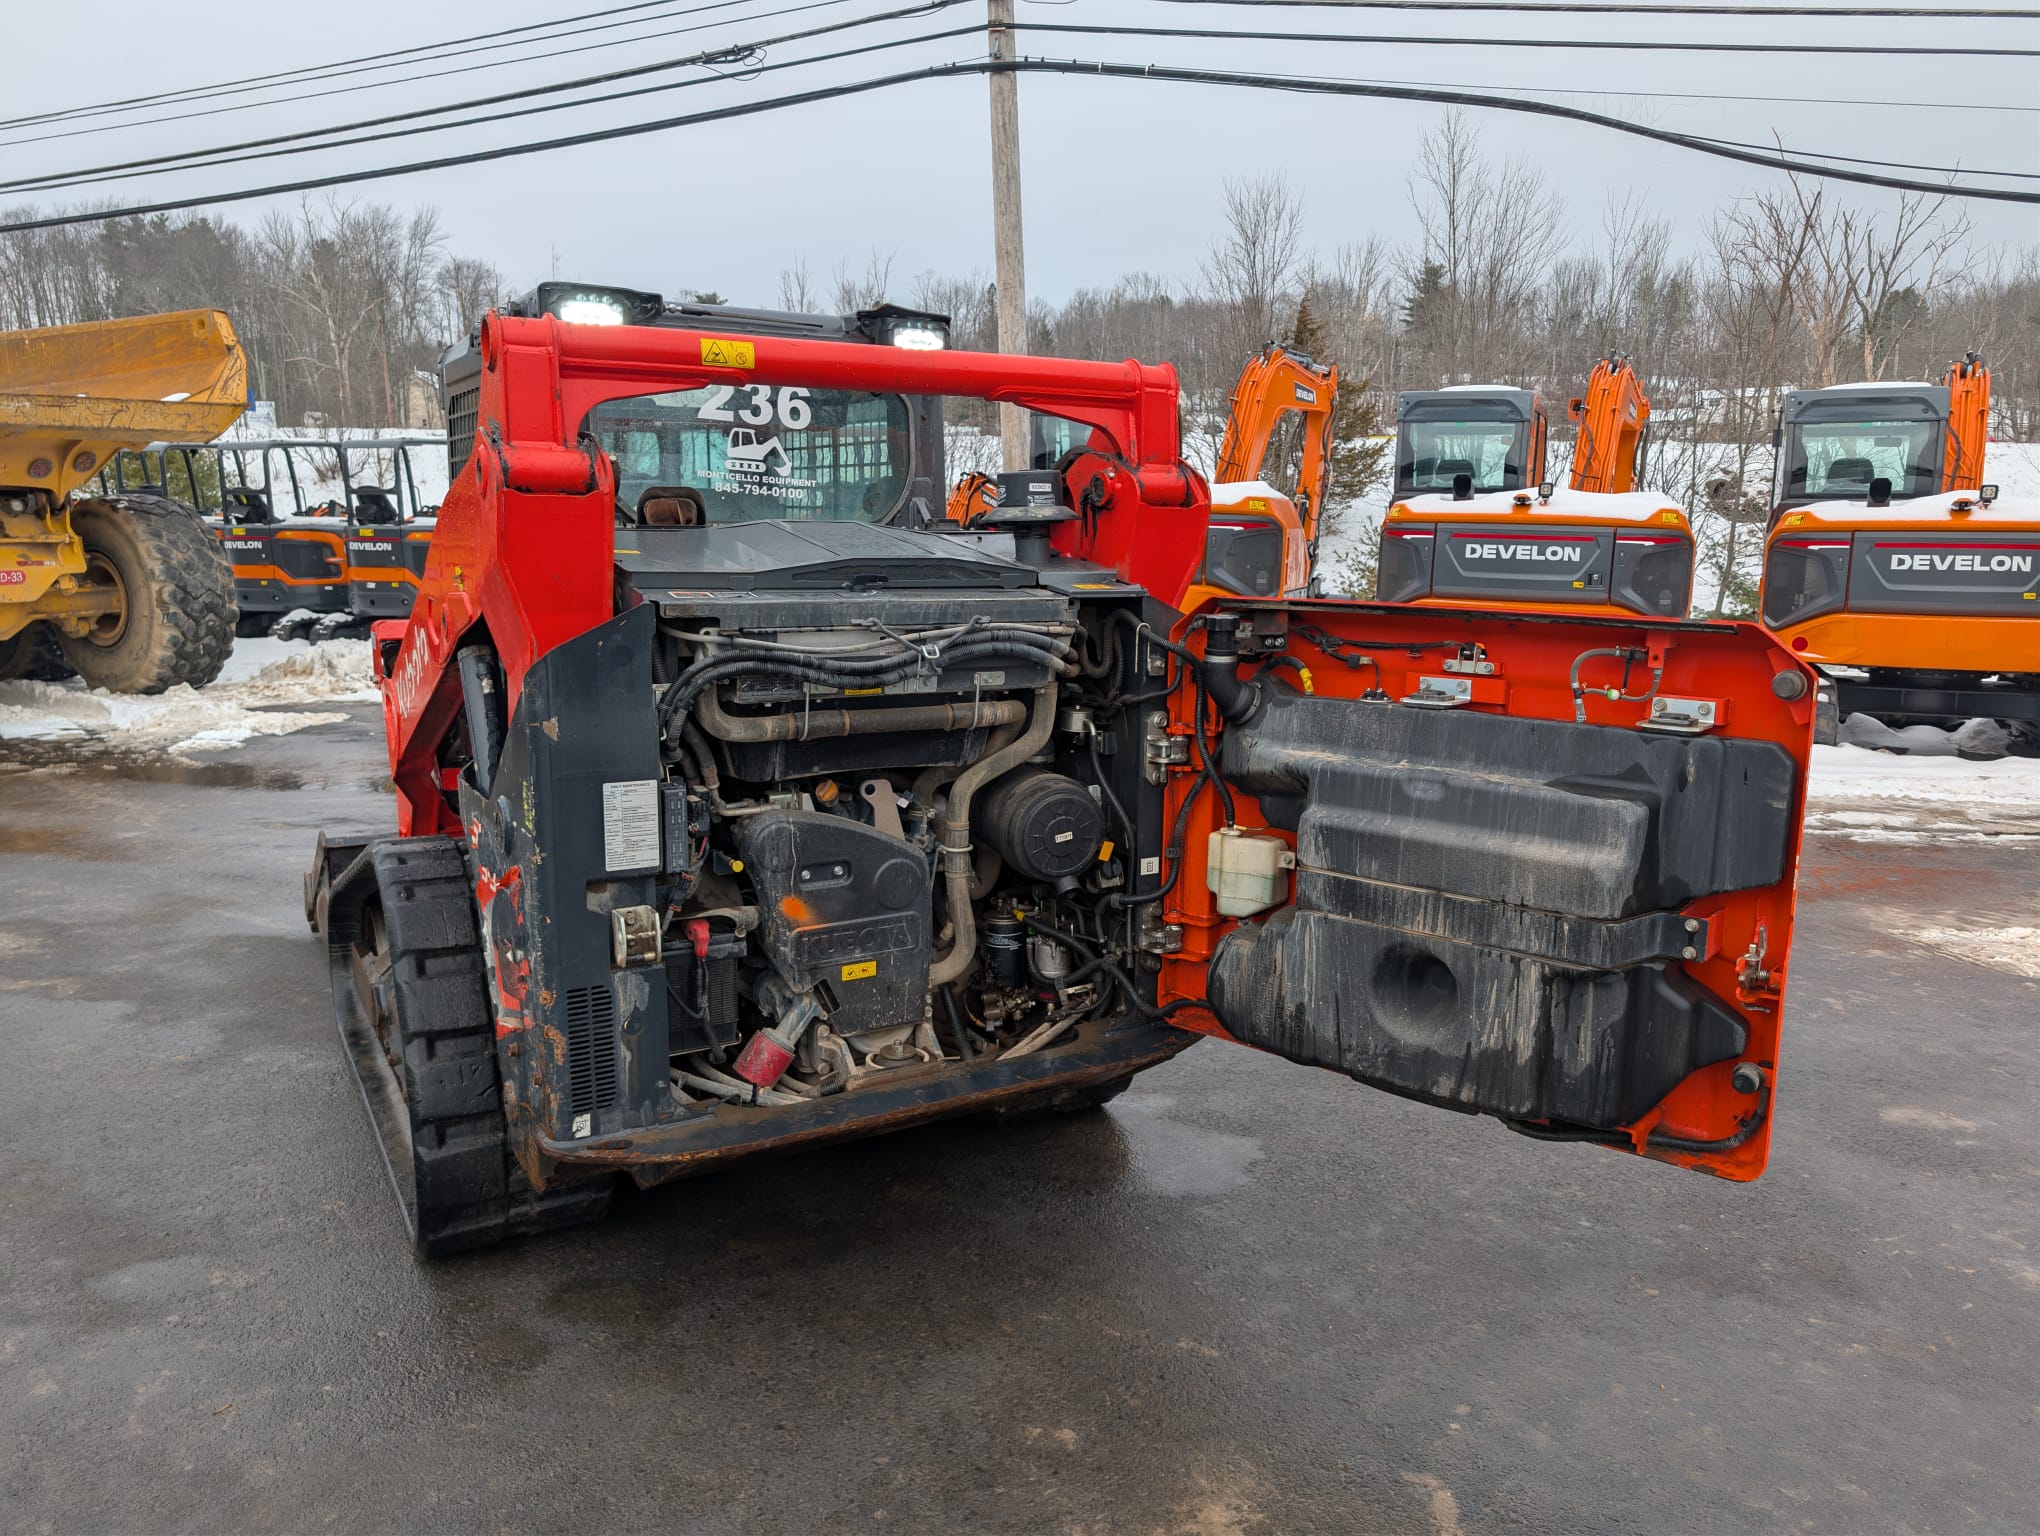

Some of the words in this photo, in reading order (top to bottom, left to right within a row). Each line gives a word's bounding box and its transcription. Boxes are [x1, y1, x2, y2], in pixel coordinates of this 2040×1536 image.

[696, 383, 812, 430] 236
[696, 470, 760, 482] MONTICELLO
[763, 476, 817, 487] EQUIPMENT
[715, 482, 803, 498] 845-794-0100
[224, 540, 263, 549] DEVELON
[350, 541, 392, 551] DEVELON
[1464, 543, 1581, 562] DEVELON
[1890, 554, 2032, 572] DEVELON
[800, 921, 917, 962] KUBOTA
